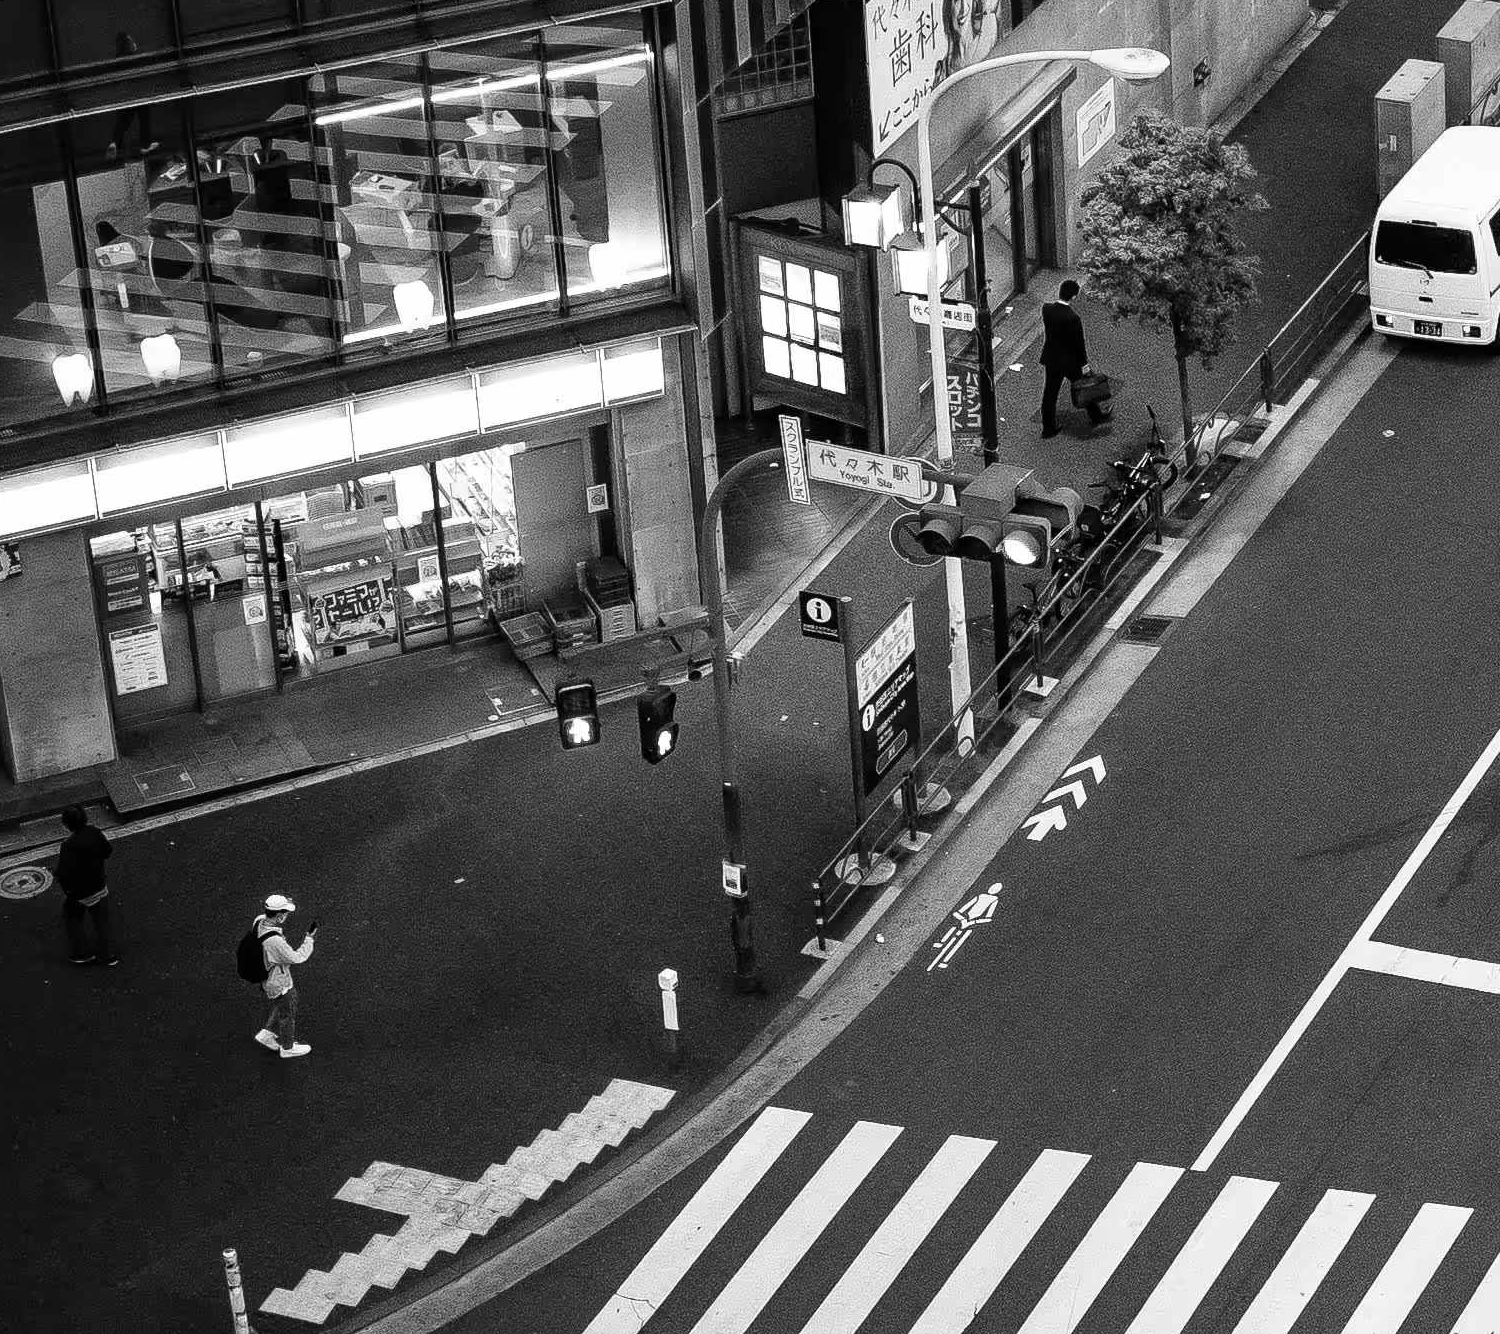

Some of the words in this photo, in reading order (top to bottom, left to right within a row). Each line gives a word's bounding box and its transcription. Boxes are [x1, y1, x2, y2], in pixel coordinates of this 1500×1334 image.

[888, 1, 939, 87] 歯科
[913, 304, 972, 323] 代々商店街
[947, 375, 963, 433] スロット
[965, 371, 982, 429] パチンコ
[819, 448, 911, 484] 代々木駅
[839, 469, 870, 485] Yoyogi
[877, 477, 896, 489] Sta.
